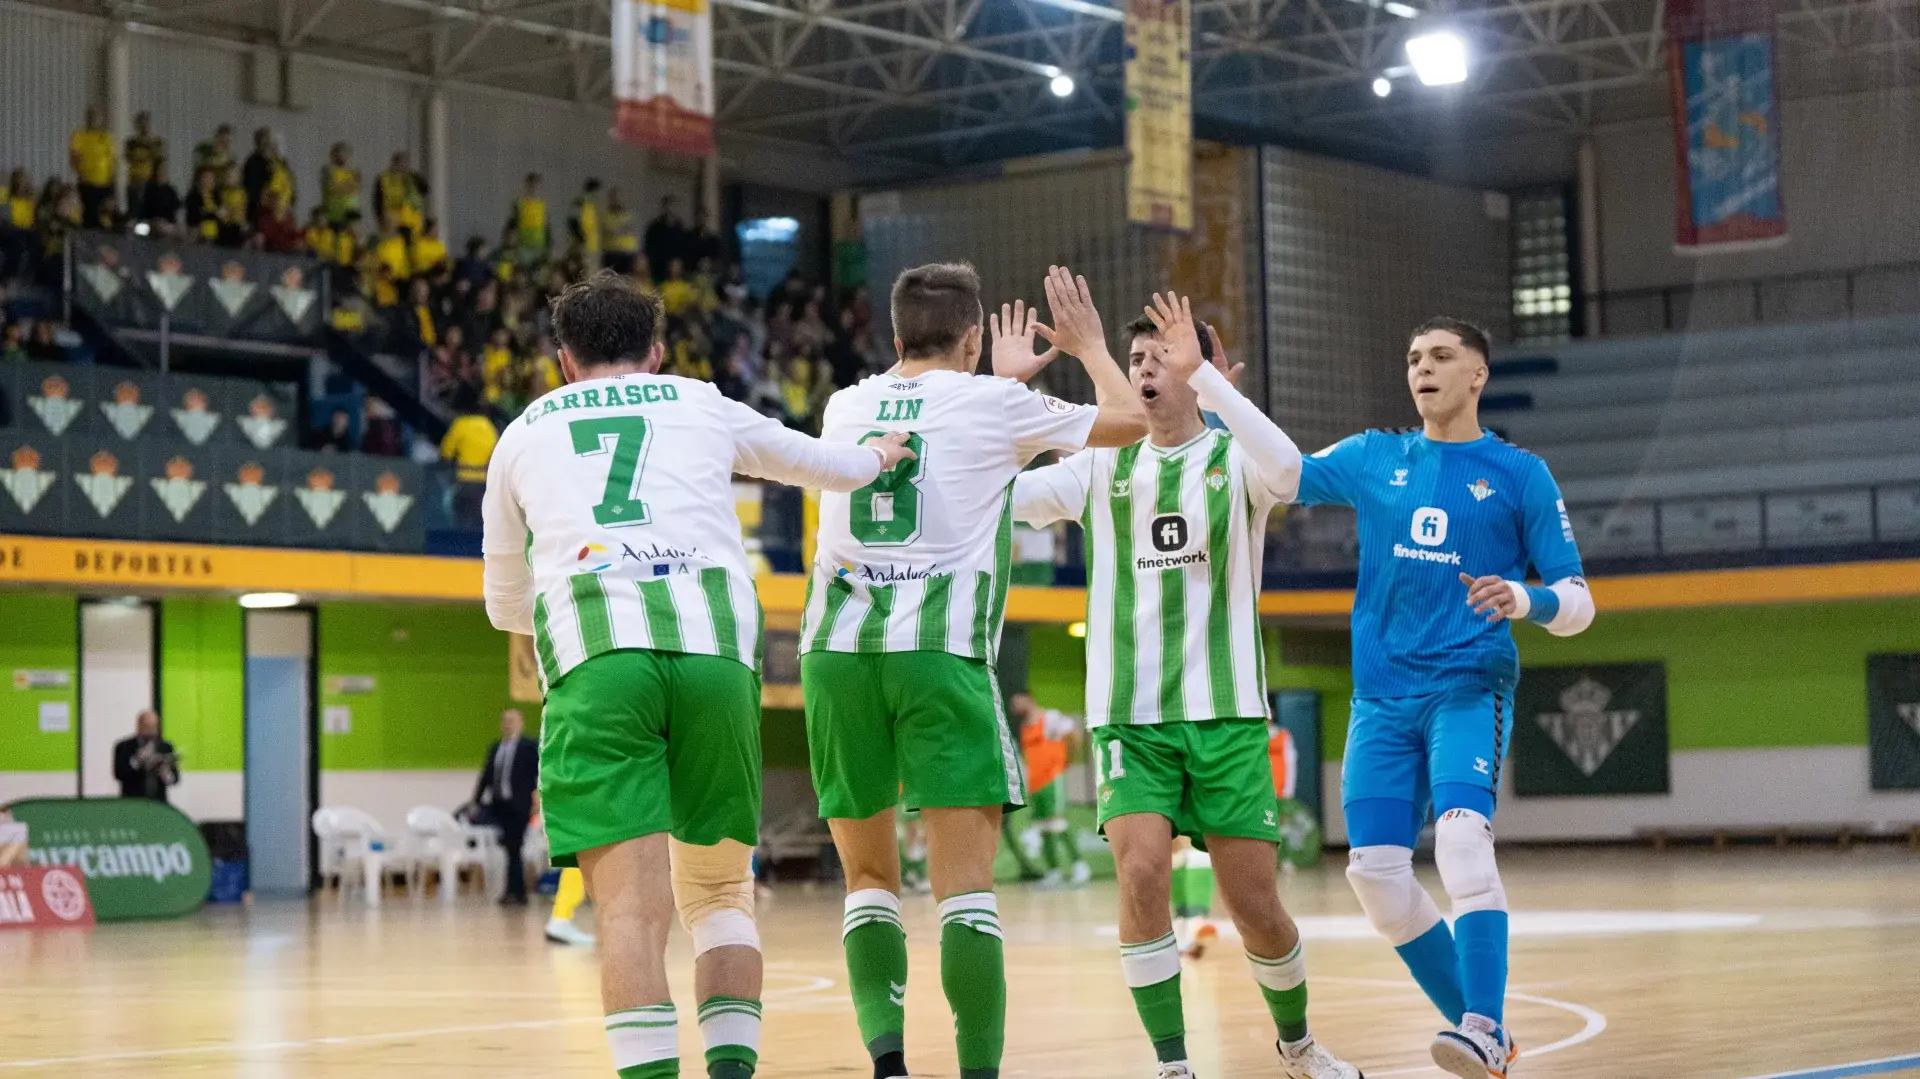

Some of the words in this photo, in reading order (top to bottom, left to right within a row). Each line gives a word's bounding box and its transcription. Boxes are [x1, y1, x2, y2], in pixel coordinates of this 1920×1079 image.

[525, 383, 679, 427] CARRASCO
[876, 399, 924, 421] LIN
[568, 415, 653, 529] 7
[850, 431, 928, 547] 8
[75, 549, 212, 575] DEPORTES
[1137, 551, 1207, 570] finetwork
[1393, 543, 1462, 565] finetwork
